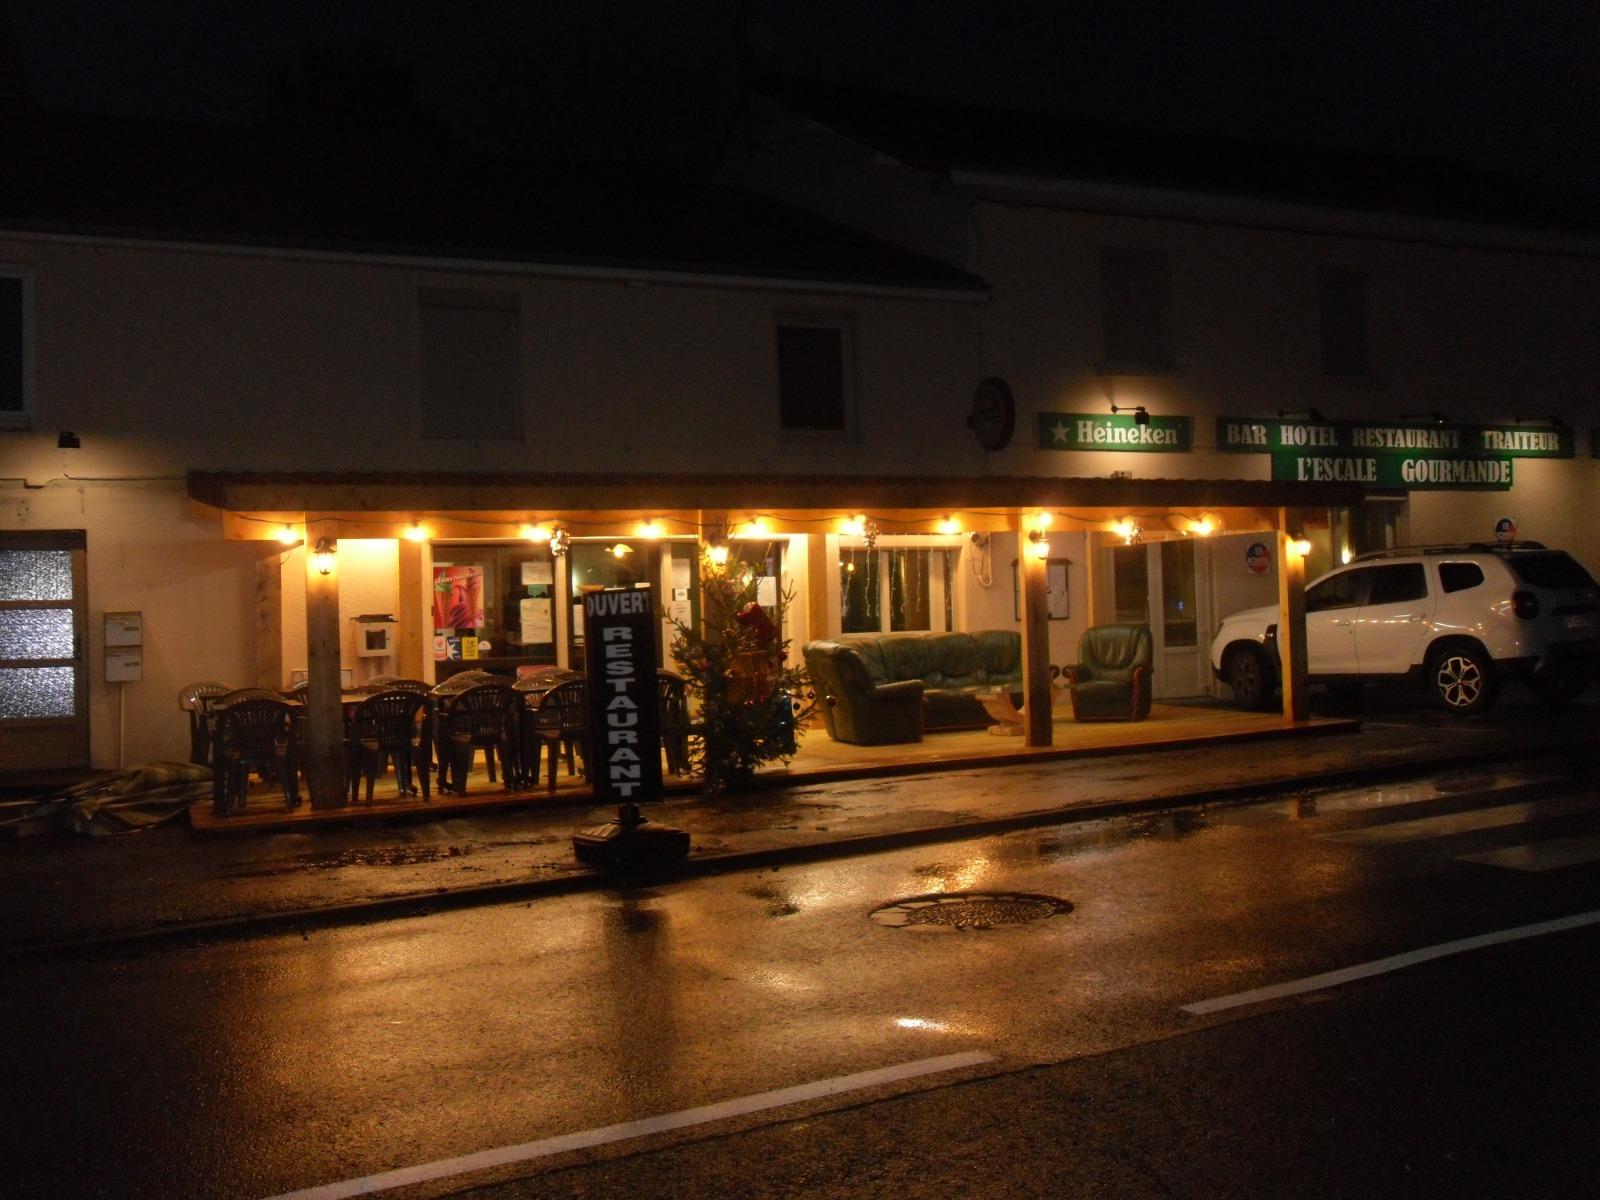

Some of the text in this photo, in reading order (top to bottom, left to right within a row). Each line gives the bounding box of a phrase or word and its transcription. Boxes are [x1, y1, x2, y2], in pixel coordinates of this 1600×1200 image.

[1076, 420, 1178, 444] Heineken
[1225, 423, 1560, 451] BAR HOTEL RESTAURANT TRAITEUR
[1296, 457, 1511, 483] L'ESCALE GOURMANDE
[602, 626, 641, 797] RESTAURANT
